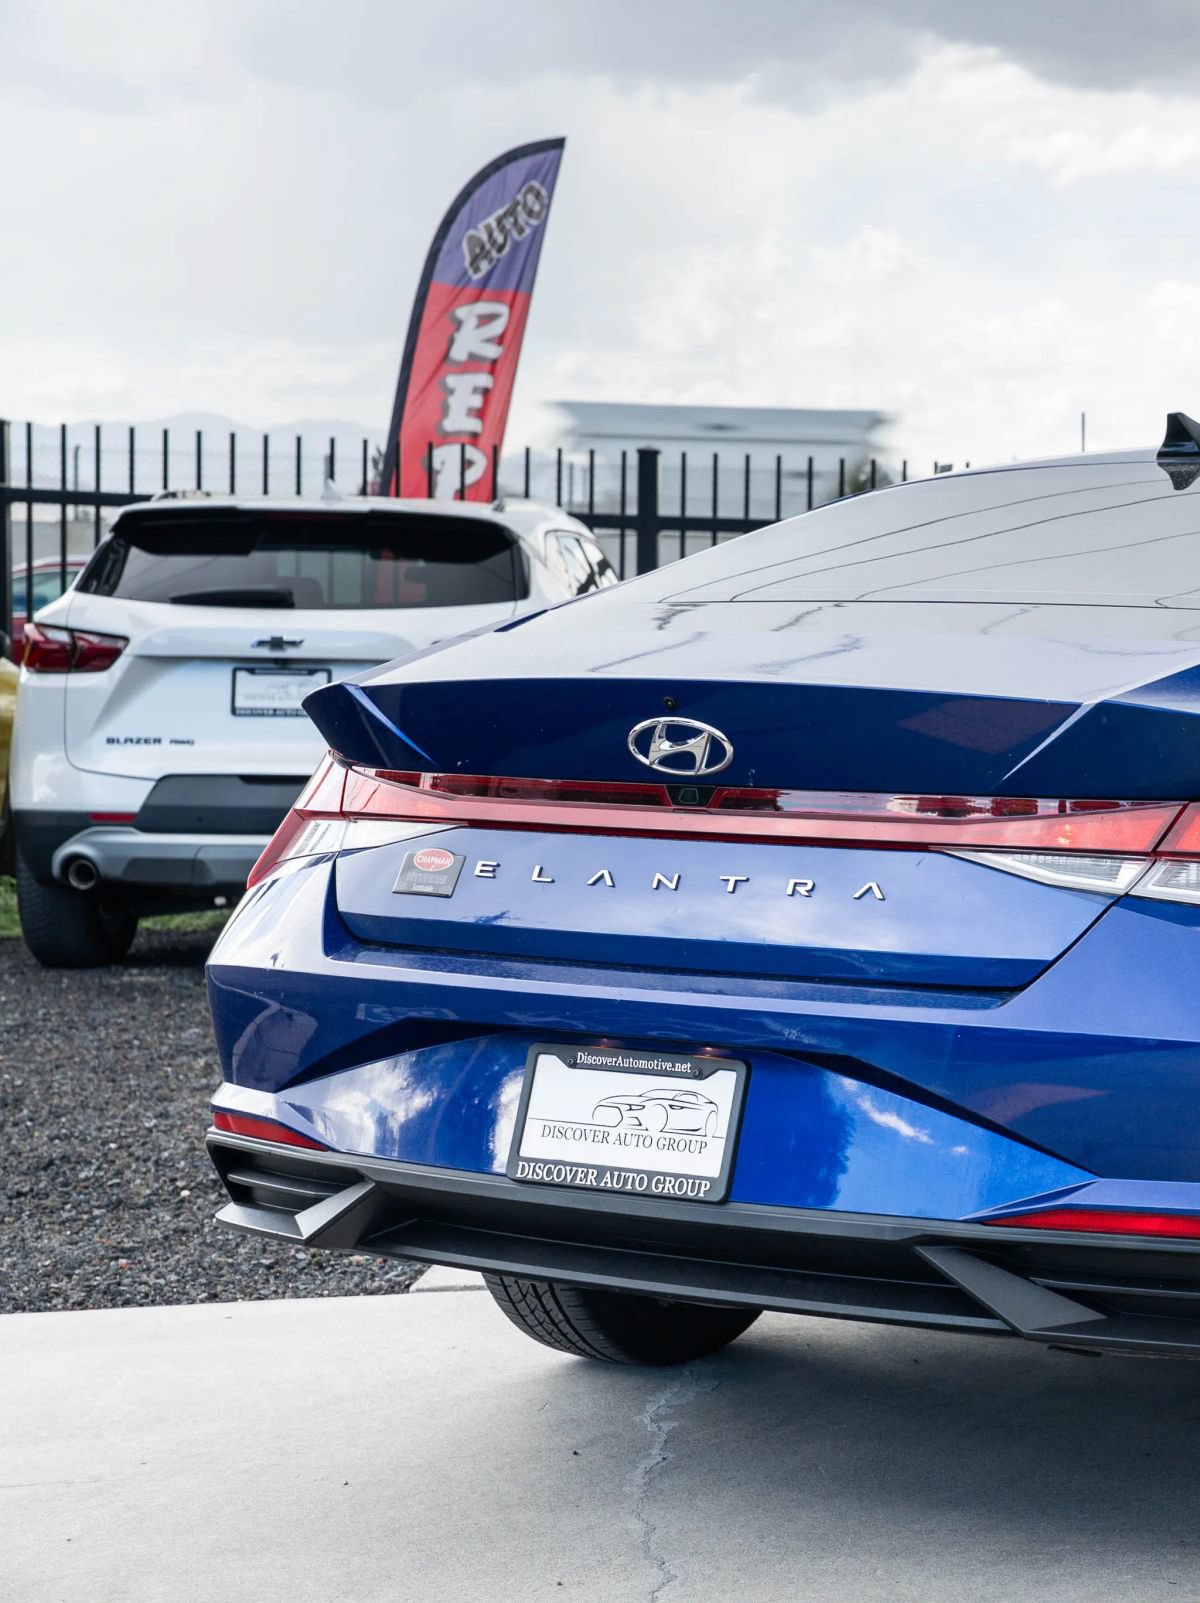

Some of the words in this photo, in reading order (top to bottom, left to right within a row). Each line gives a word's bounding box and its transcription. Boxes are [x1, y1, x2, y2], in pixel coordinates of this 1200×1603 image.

[463, 181, 547, 278] AUTO
[106, 736, 162, 745] BLAZER
[416, 854, 451, 865] CHAPMAN
[473, 860, 885, 900] ELANTRA
[576, 1052, 692, 1073] DiscoverAutomotive.net
[541, 1124, 610, 1145] DISCOVER
[613, 1132, 653, 1149] AUTO
[656, 1136, 708, 1154] GROUP
[515, 1161, 598, 1187] DISCOVER
[600, 1170, 648, 1191] AUTO
[652, 1175, 711, 1197] GROUP
